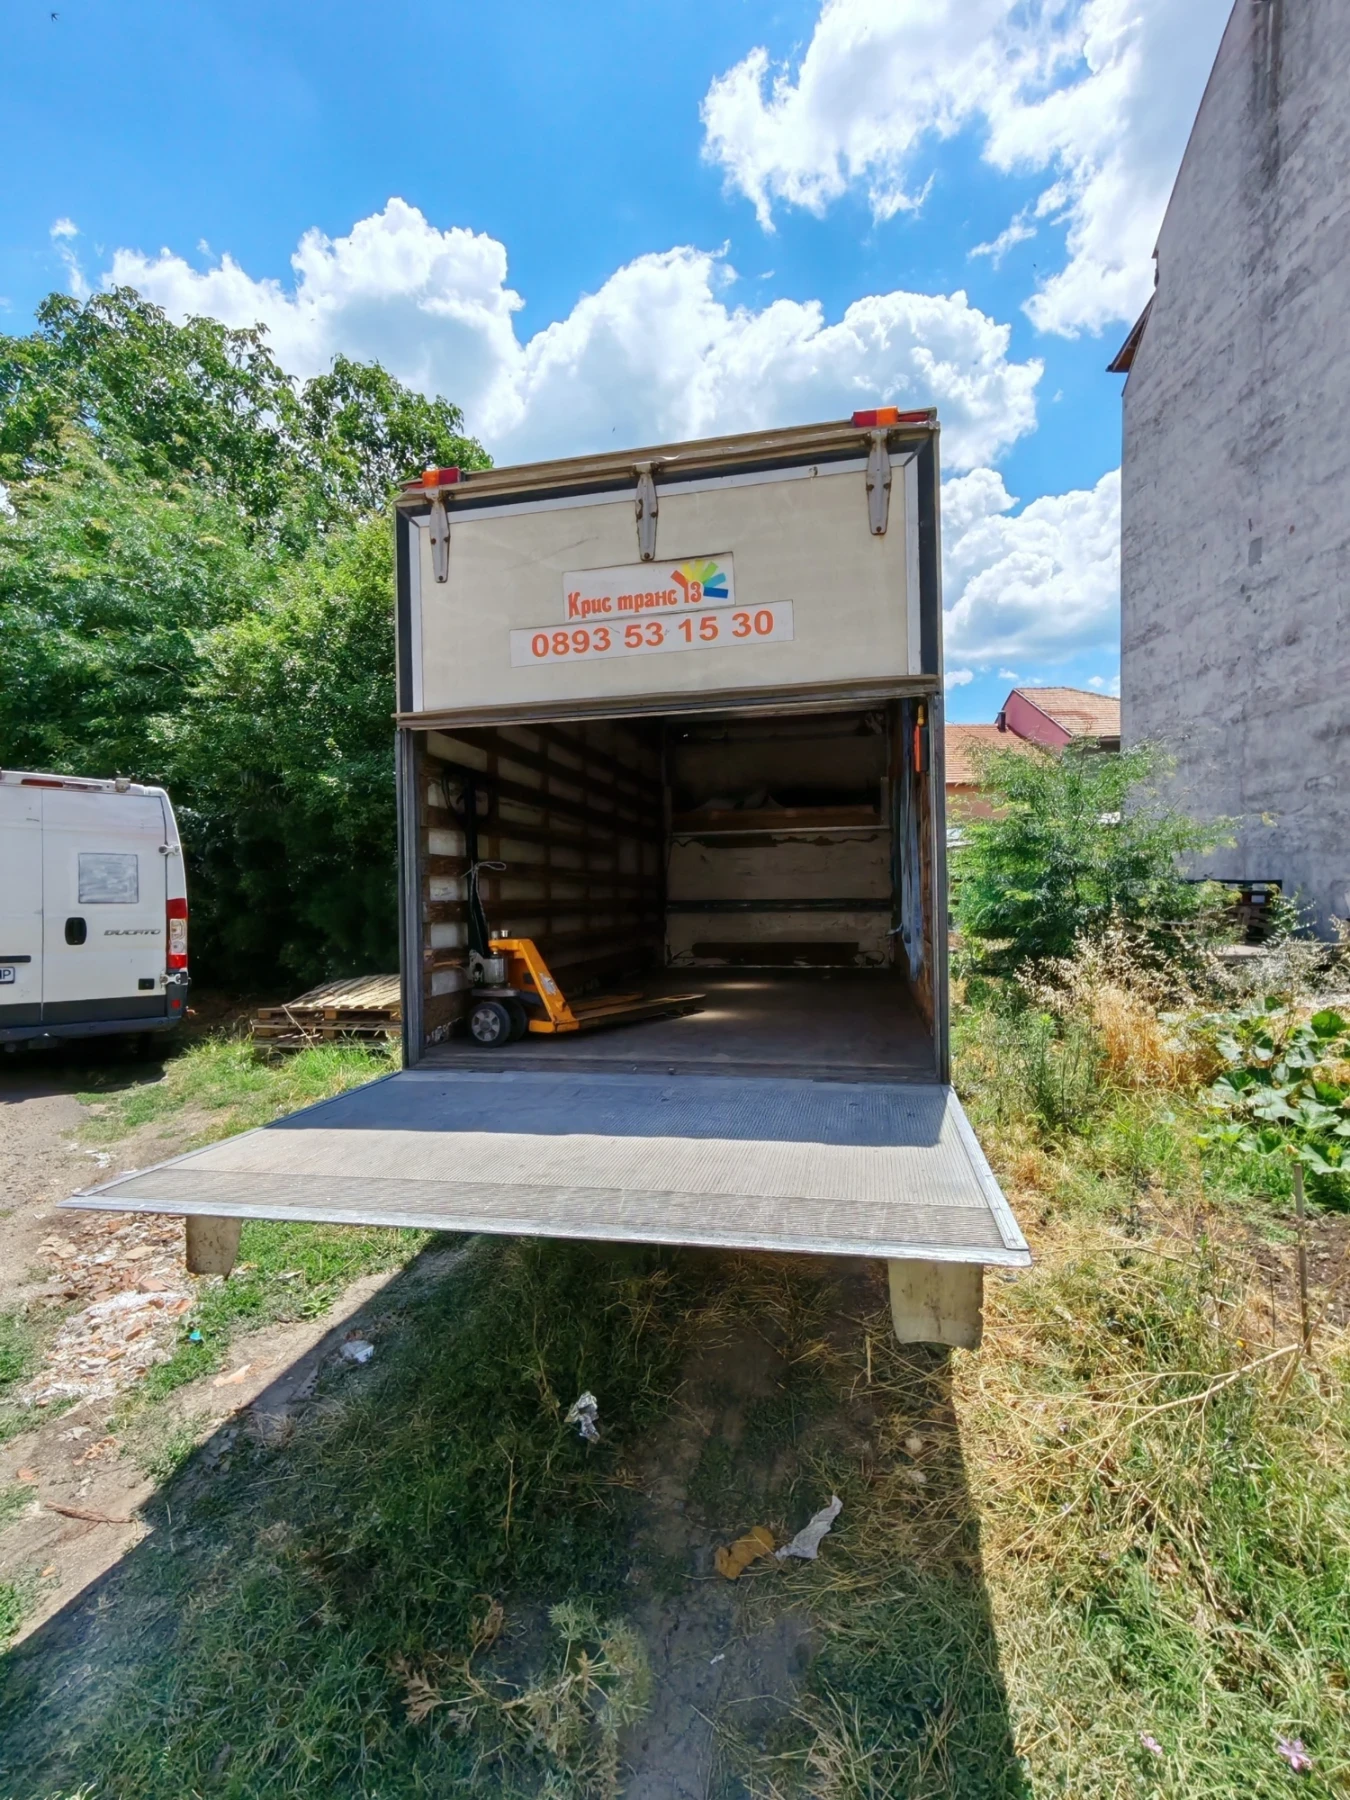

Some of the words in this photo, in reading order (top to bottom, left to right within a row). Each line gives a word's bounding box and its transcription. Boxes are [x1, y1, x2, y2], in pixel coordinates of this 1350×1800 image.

[567, 591, 612, 619] Крис
[617, 589, 678, 613] транс
[674, 573, 702, 604] 13
[531, 627, 612, 658] 0893
[624, 622, 665, 649] 53
[678, 616, 720, 643] 15
[732, 609, 775, 638] 30
[0, 968, 12, 980] P
